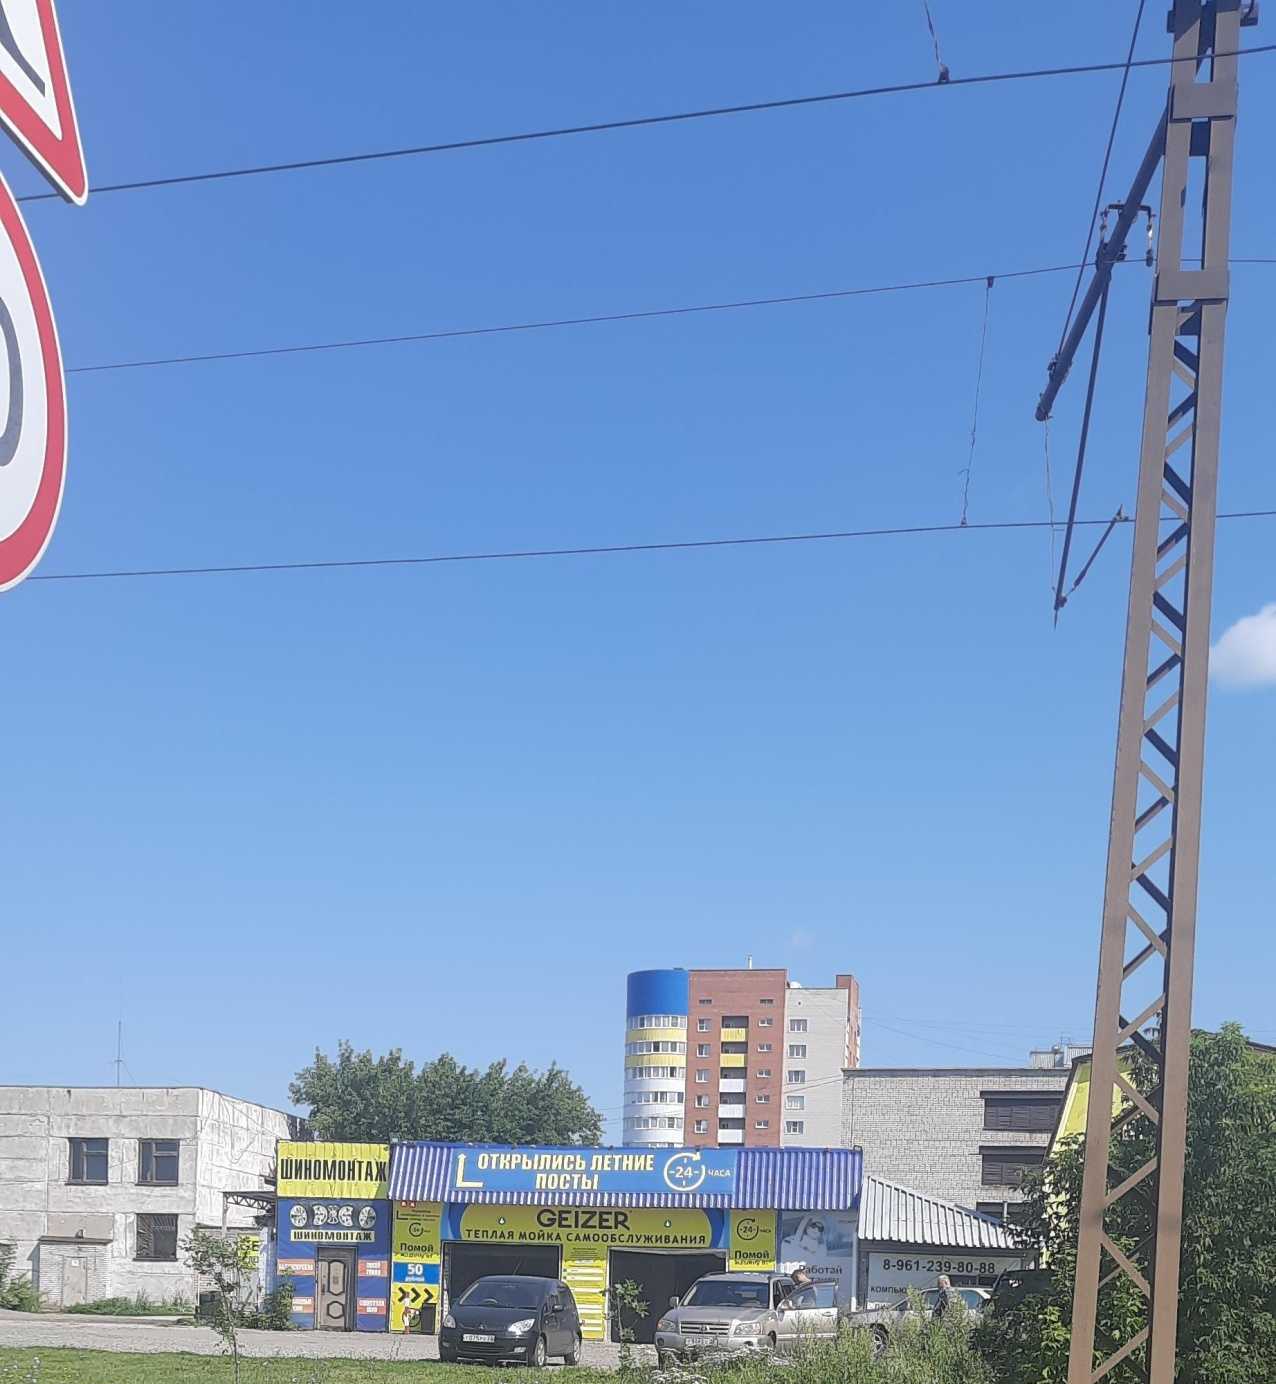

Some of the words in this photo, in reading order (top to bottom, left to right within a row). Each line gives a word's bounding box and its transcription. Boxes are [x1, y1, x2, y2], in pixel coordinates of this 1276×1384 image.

[280, 1158, 387, 1182] ШИНОМОНТАЖ
[477, 1153, 585, 1171] ОТКРЫЛИСЬ
[590, 1154, 655, 1172] ЛЕТНИЕ
[535, 1173, 599, 1190] ПОСТЫ
[536, 1208, 630, 1231] GEIZER
[293, 1230, 373, 1241] ШИНОМОНТАЖ
[465, 1228, 514, 1240] ТЕПЛАЯ
[518, 1229, 562, 1242] МОЙКА
[566, 1232, 706, 1245] САМООБСЛУЖИВАНИЯ
[400, 1243, 434, 1253] Помой
[734, 1250, 769, 1259] Помой
[407, 1263, 424, 1276] 50
[882, 1258, 996, 1274] 8-961-239-80-88
